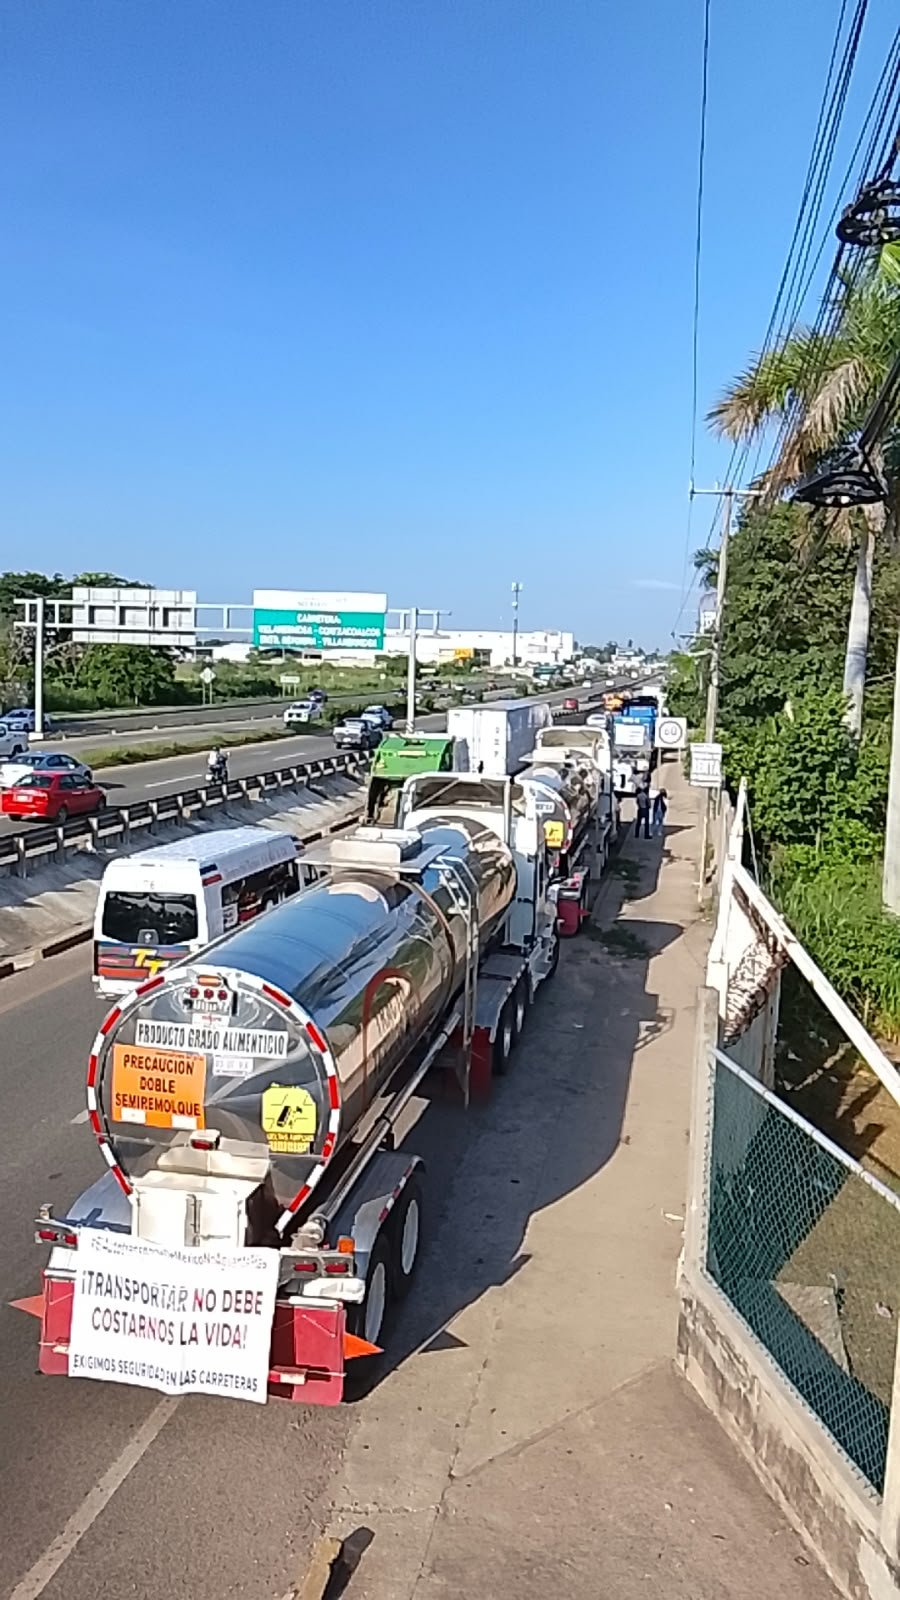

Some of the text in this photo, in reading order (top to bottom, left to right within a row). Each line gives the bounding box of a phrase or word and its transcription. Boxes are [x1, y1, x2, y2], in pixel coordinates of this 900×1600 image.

[138, 1023, 285, 1056] PRODUCTO GRADO ALIMENTICIO
[123, 1054, 194, 1076] PRECAUCION
[139, 1076, 176, 1094] DOBLE
[115, 1094, 201, 1117] SEMIREMOLQUE
[192, 1287, 217, 1313] NO
[222, 1290, 264, 1315] DEBE
[91, 1307, 248, 1350] COSTARNOS LA VIDA!
[73, 1354, 258, 1393] EXIGIMOS SEGURIDAD EN LAS CARRETERAS
